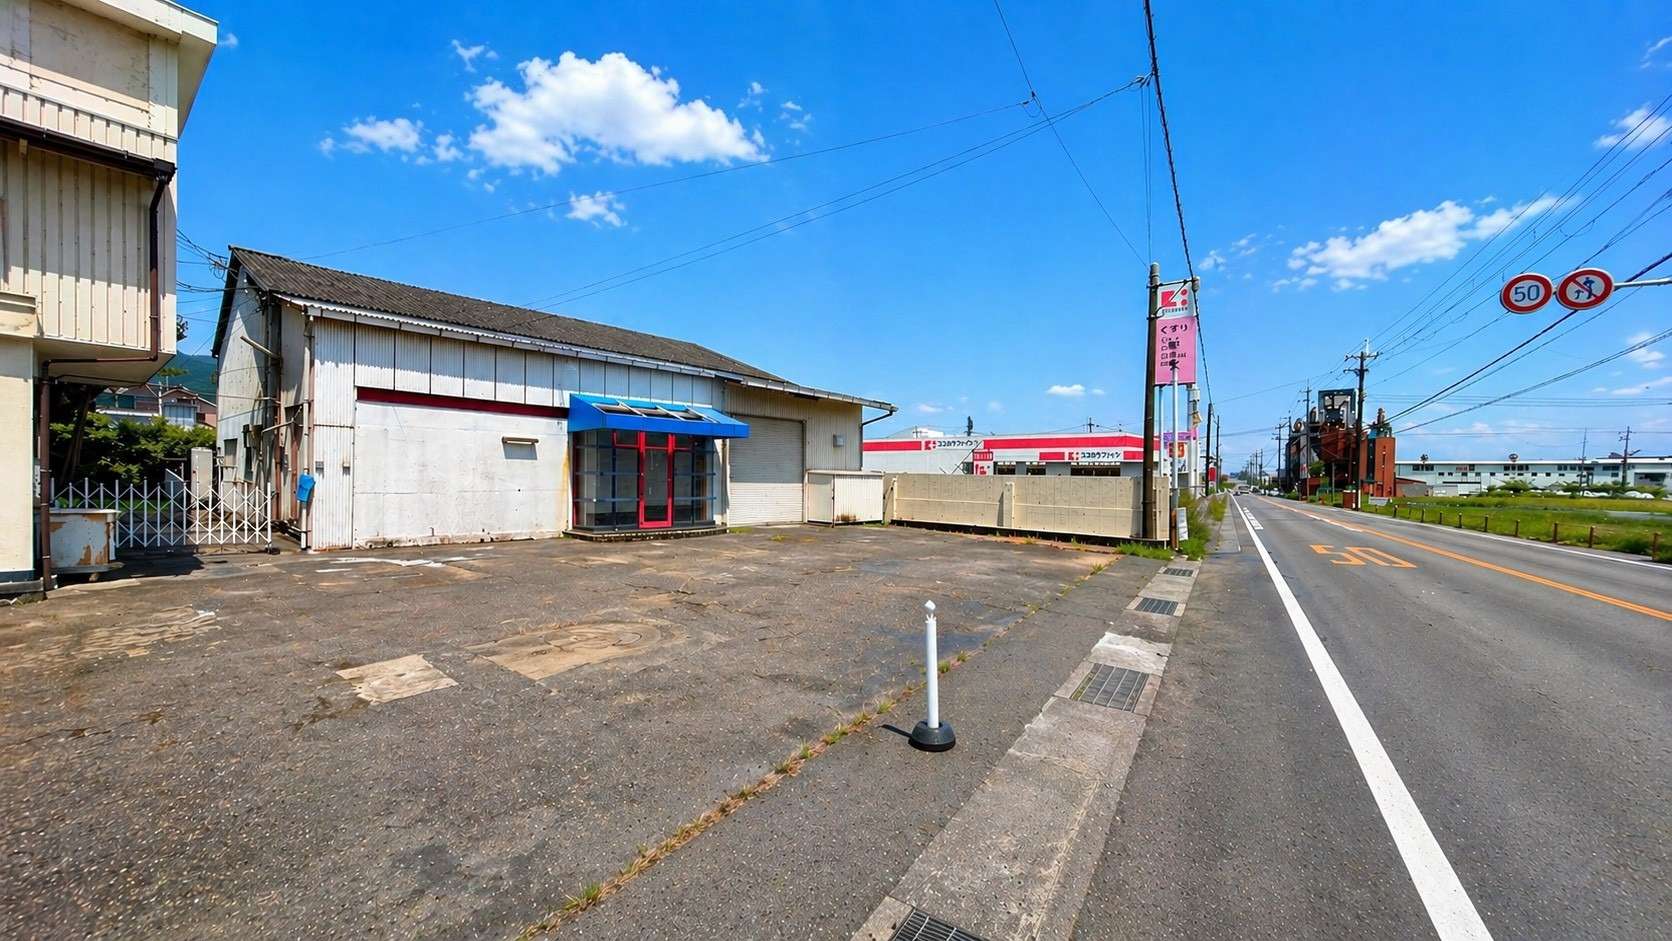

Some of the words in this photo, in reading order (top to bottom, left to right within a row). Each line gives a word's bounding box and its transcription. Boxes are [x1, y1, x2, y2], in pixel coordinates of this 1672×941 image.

[1514, 284, 1540, 302] 50
[1161, 324, 1188, 334] くすり
[1309, 544, 1418, 568] 50
